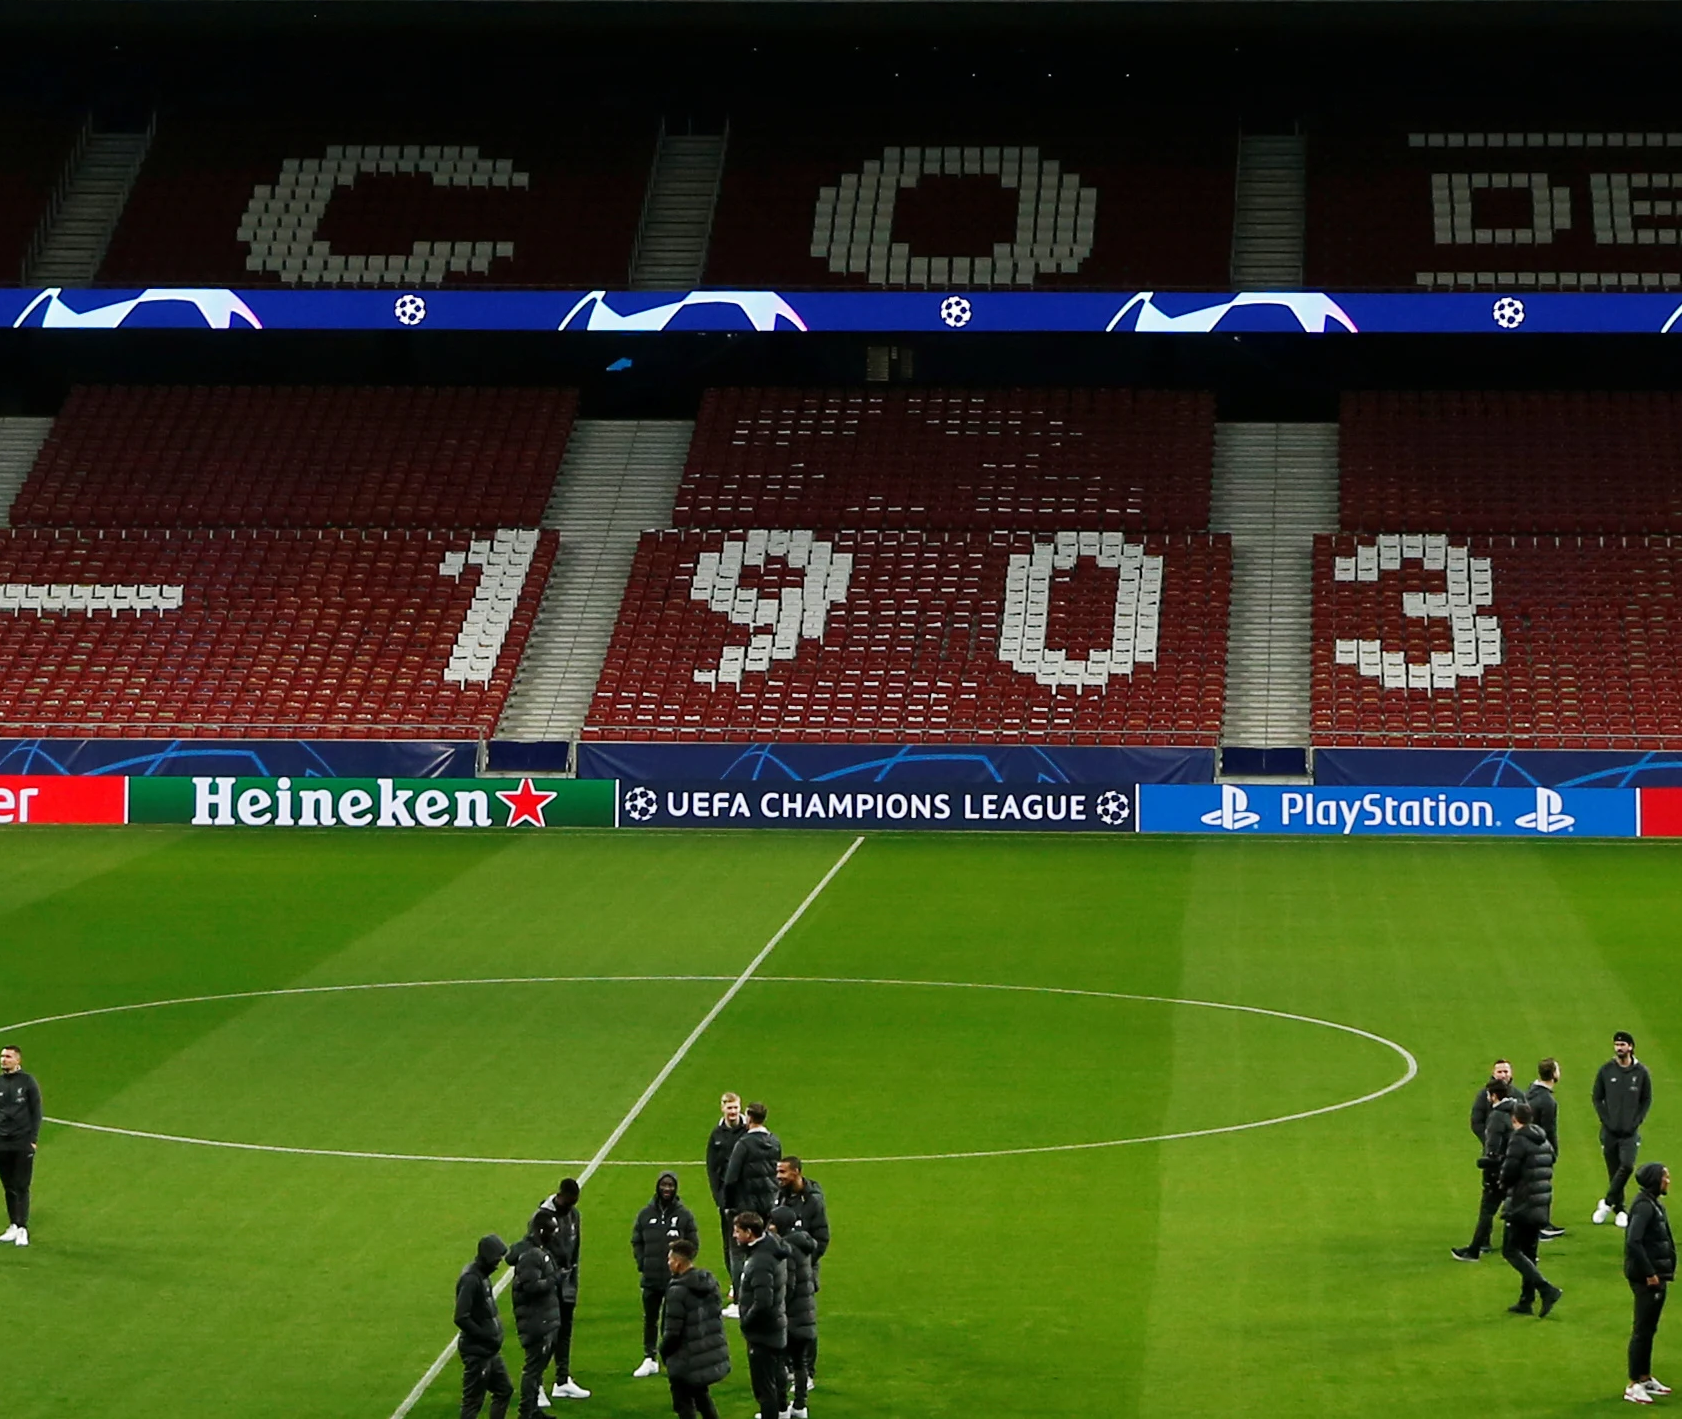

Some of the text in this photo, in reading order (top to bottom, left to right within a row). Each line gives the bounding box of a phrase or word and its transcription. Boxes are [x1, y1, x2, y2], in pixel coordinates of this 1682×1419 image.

[191, 777, 492, 827] Heineken
[667, 791, 1087, 822] UEFA CHAMPIONS LEAGUE
[1281, 793, 1487, 835] PlayStation
